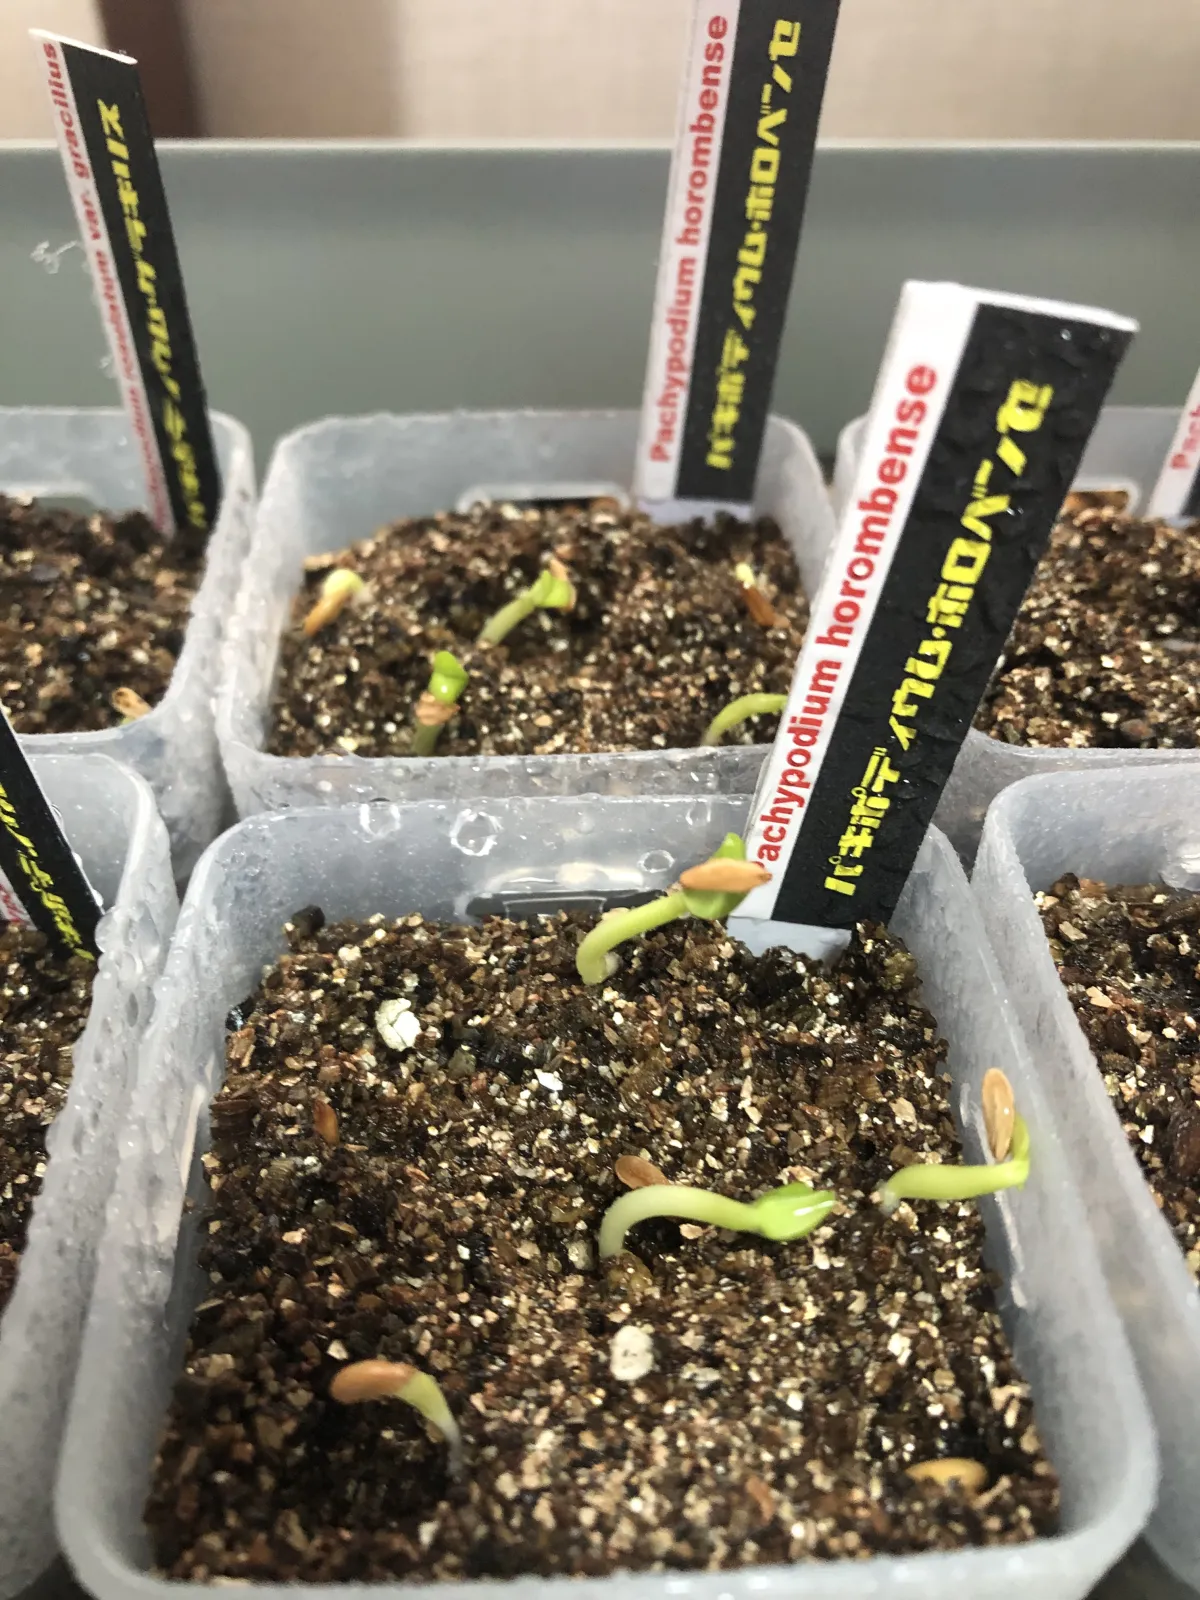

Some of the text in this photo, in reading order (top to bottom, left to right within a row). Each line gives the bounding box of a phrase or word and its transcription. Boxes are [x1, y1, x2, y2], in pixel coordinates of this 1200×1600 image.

[43, 41, 91, 180] gracilius
[650, 15, 729, 464] Pachypodium horombense
[751, 363, 938, 869] achypodium horombense
